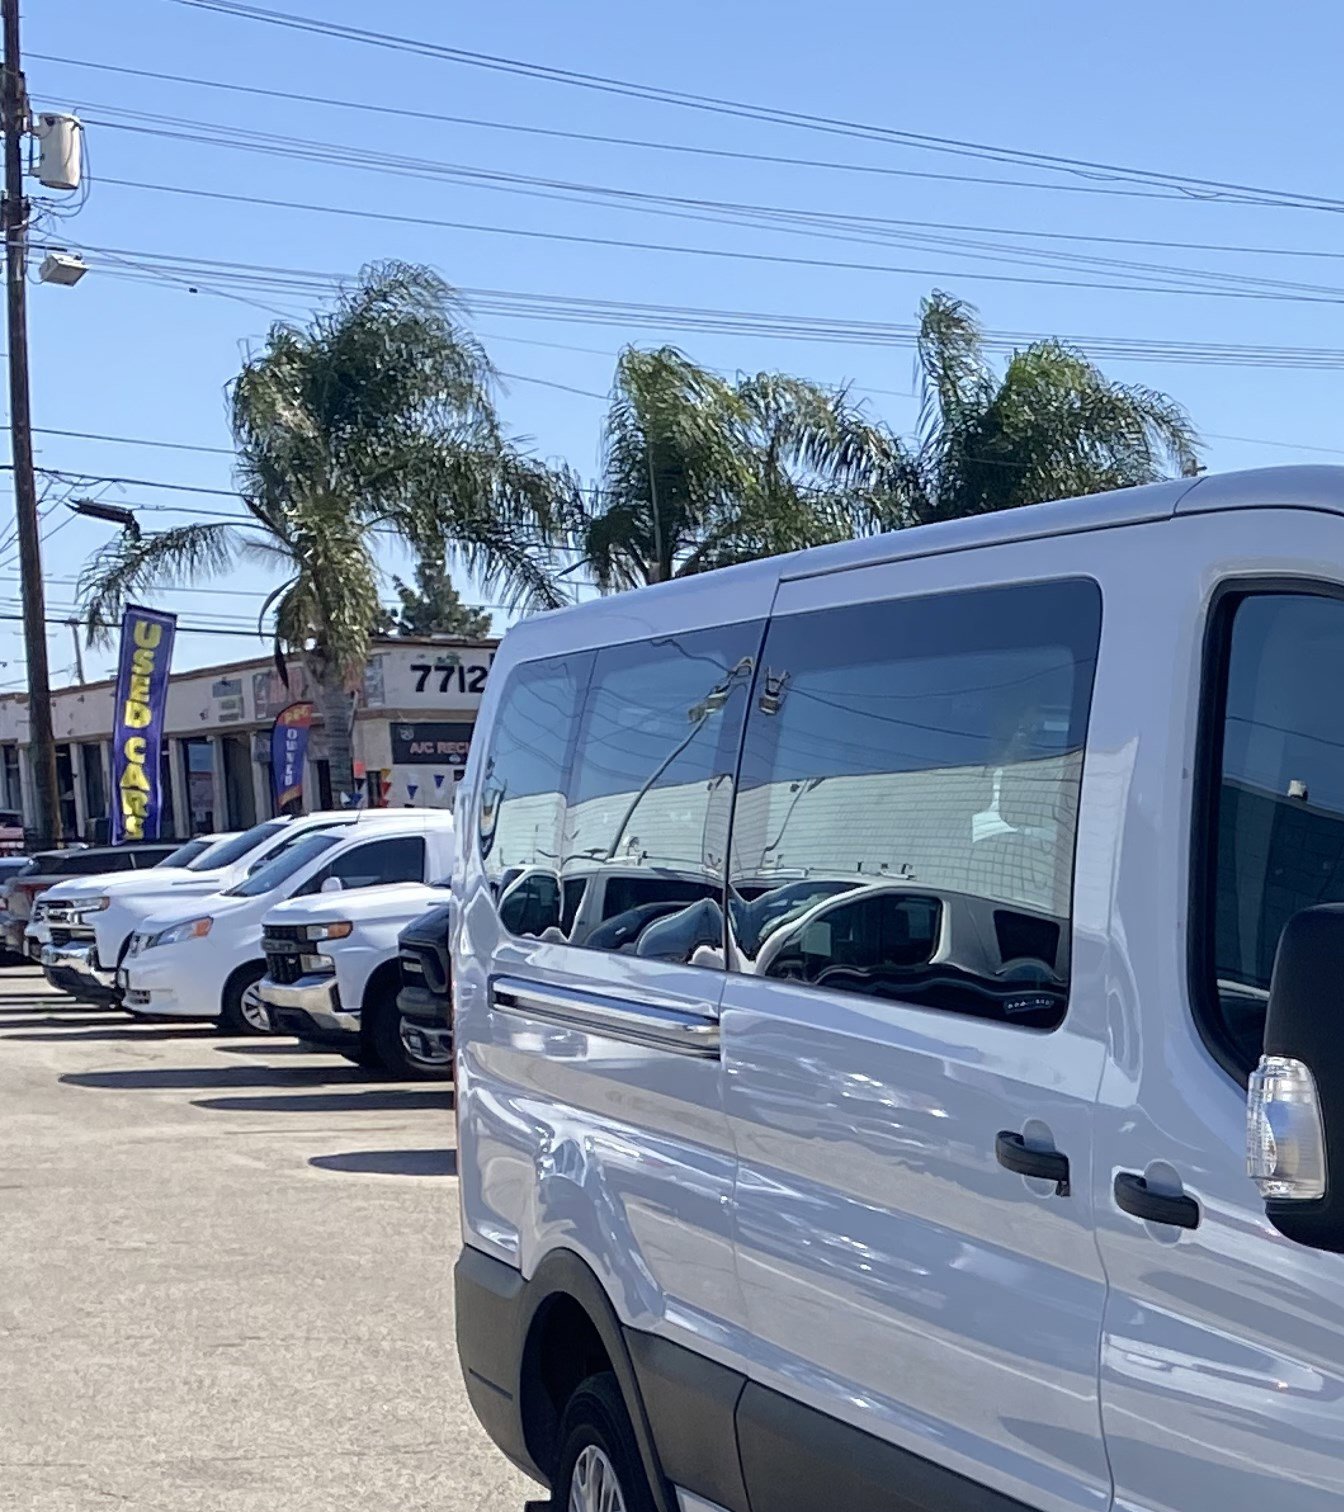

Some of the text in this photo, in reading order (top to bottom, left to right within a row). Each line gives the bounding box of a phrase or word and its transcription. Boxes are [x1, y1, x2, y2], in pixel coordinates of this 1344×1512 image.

[410, 664, 488, 693] 7712
[120, 620, 162, 840] USED CARS
[437, 741, 469, 754] REC
